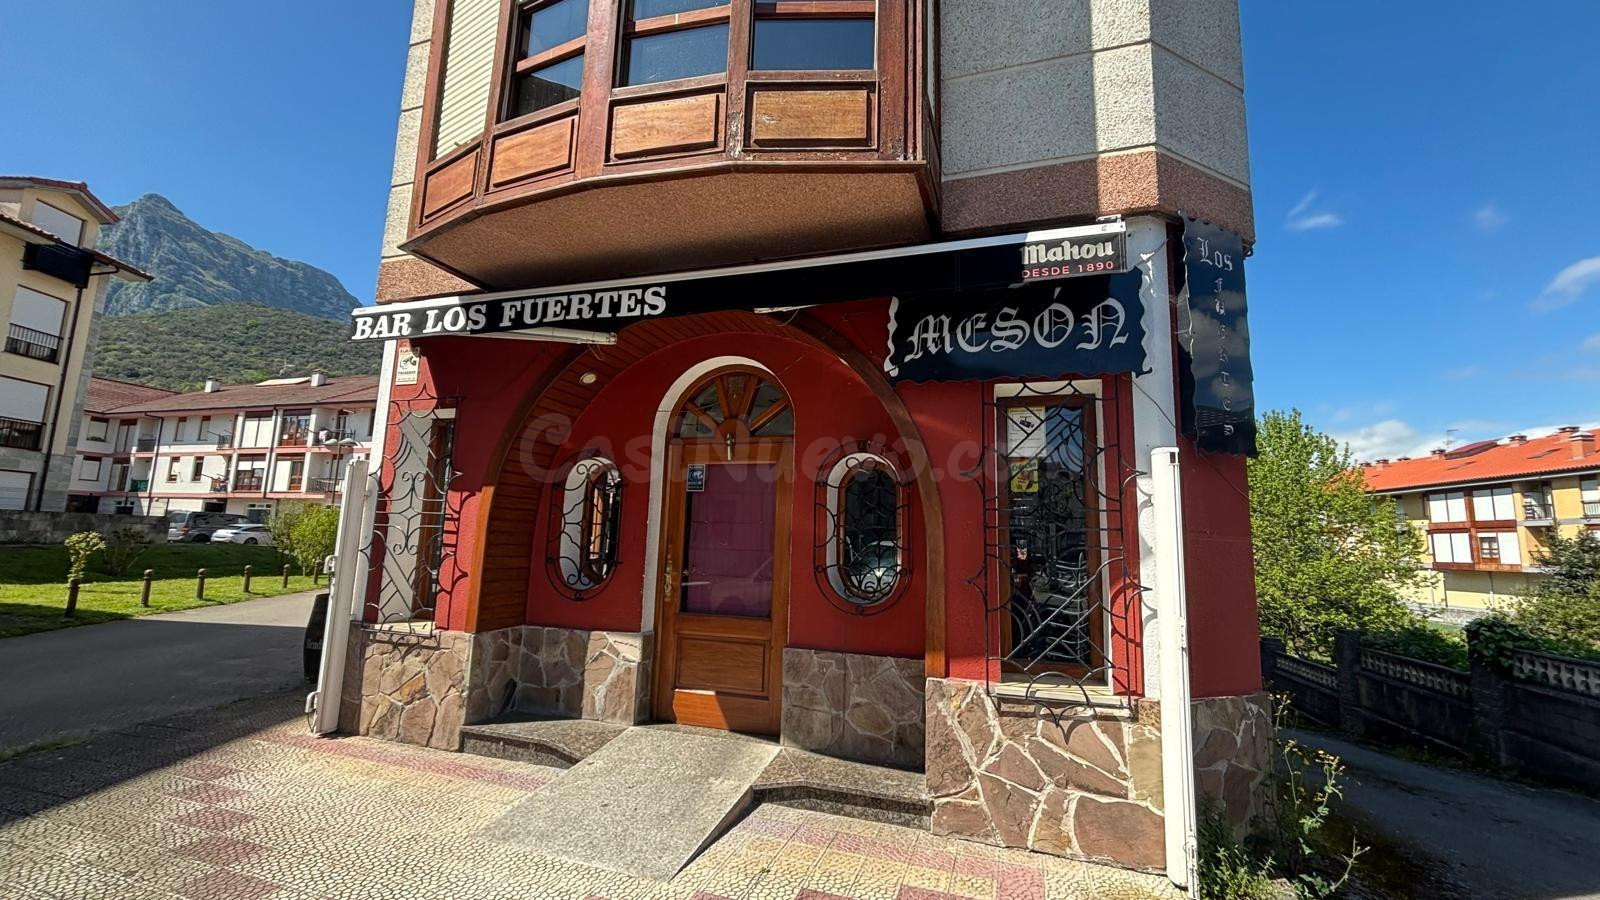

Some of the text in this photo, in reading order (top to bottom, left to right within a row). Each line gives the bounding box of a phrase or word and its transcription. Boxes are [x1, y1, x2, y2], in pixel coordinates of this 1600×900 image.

[1022, 260, 1115, 279] DESDE 1890
[1023, 240, 1115, 265] Mahou
[1197, 237, 1233, 271] Los
[351, 286, 667, 340] BAR LOS FUERTES
[903, 287, 1130, 363] MESÓN
